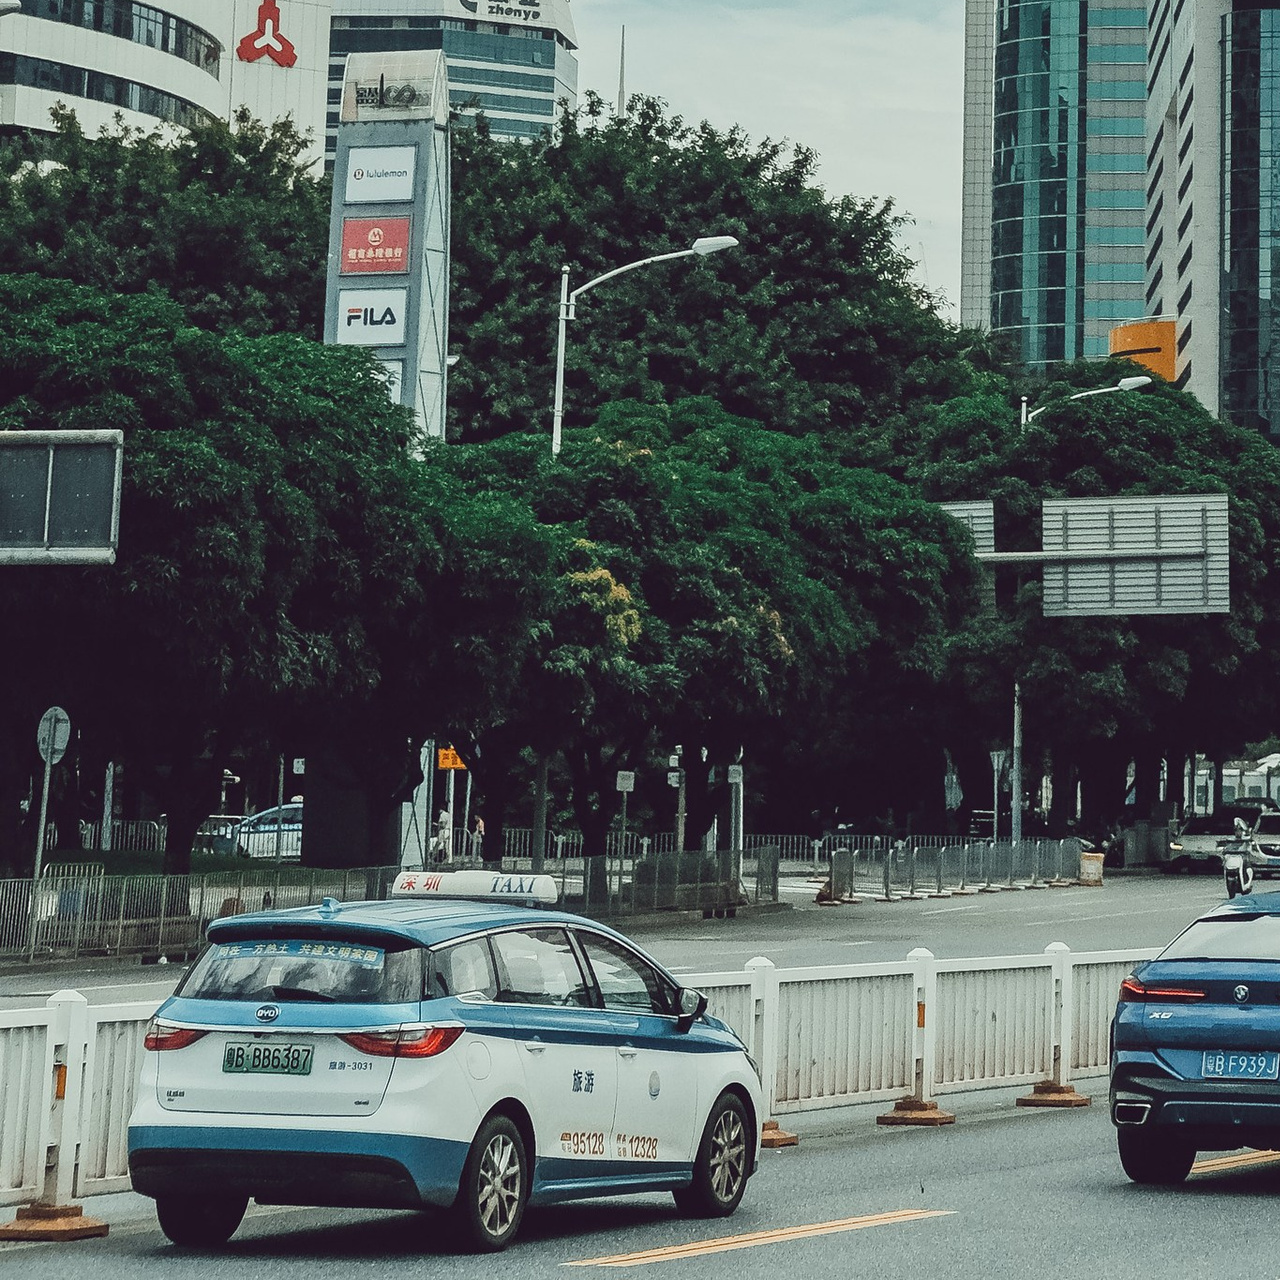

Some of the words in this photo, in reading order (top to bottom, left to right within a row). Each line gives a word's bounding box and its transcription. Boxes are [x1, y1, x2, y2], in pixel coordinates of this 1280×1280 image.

[366, 169, 408, 178] lululemon
[346, 306, 397, 327] FILA
[400, 874, 443, 891] 深圳
[491, 876, 536, 894] TAXI
[218, 943, 289, 957] 同在一方热土
[298, 944, 380, 962] 共建文明家园
[572, 1069, 595, 1094] 旅游
[572, 1132, 605, 1155] 95128
[628, 1135, 659, 1160] 12328
